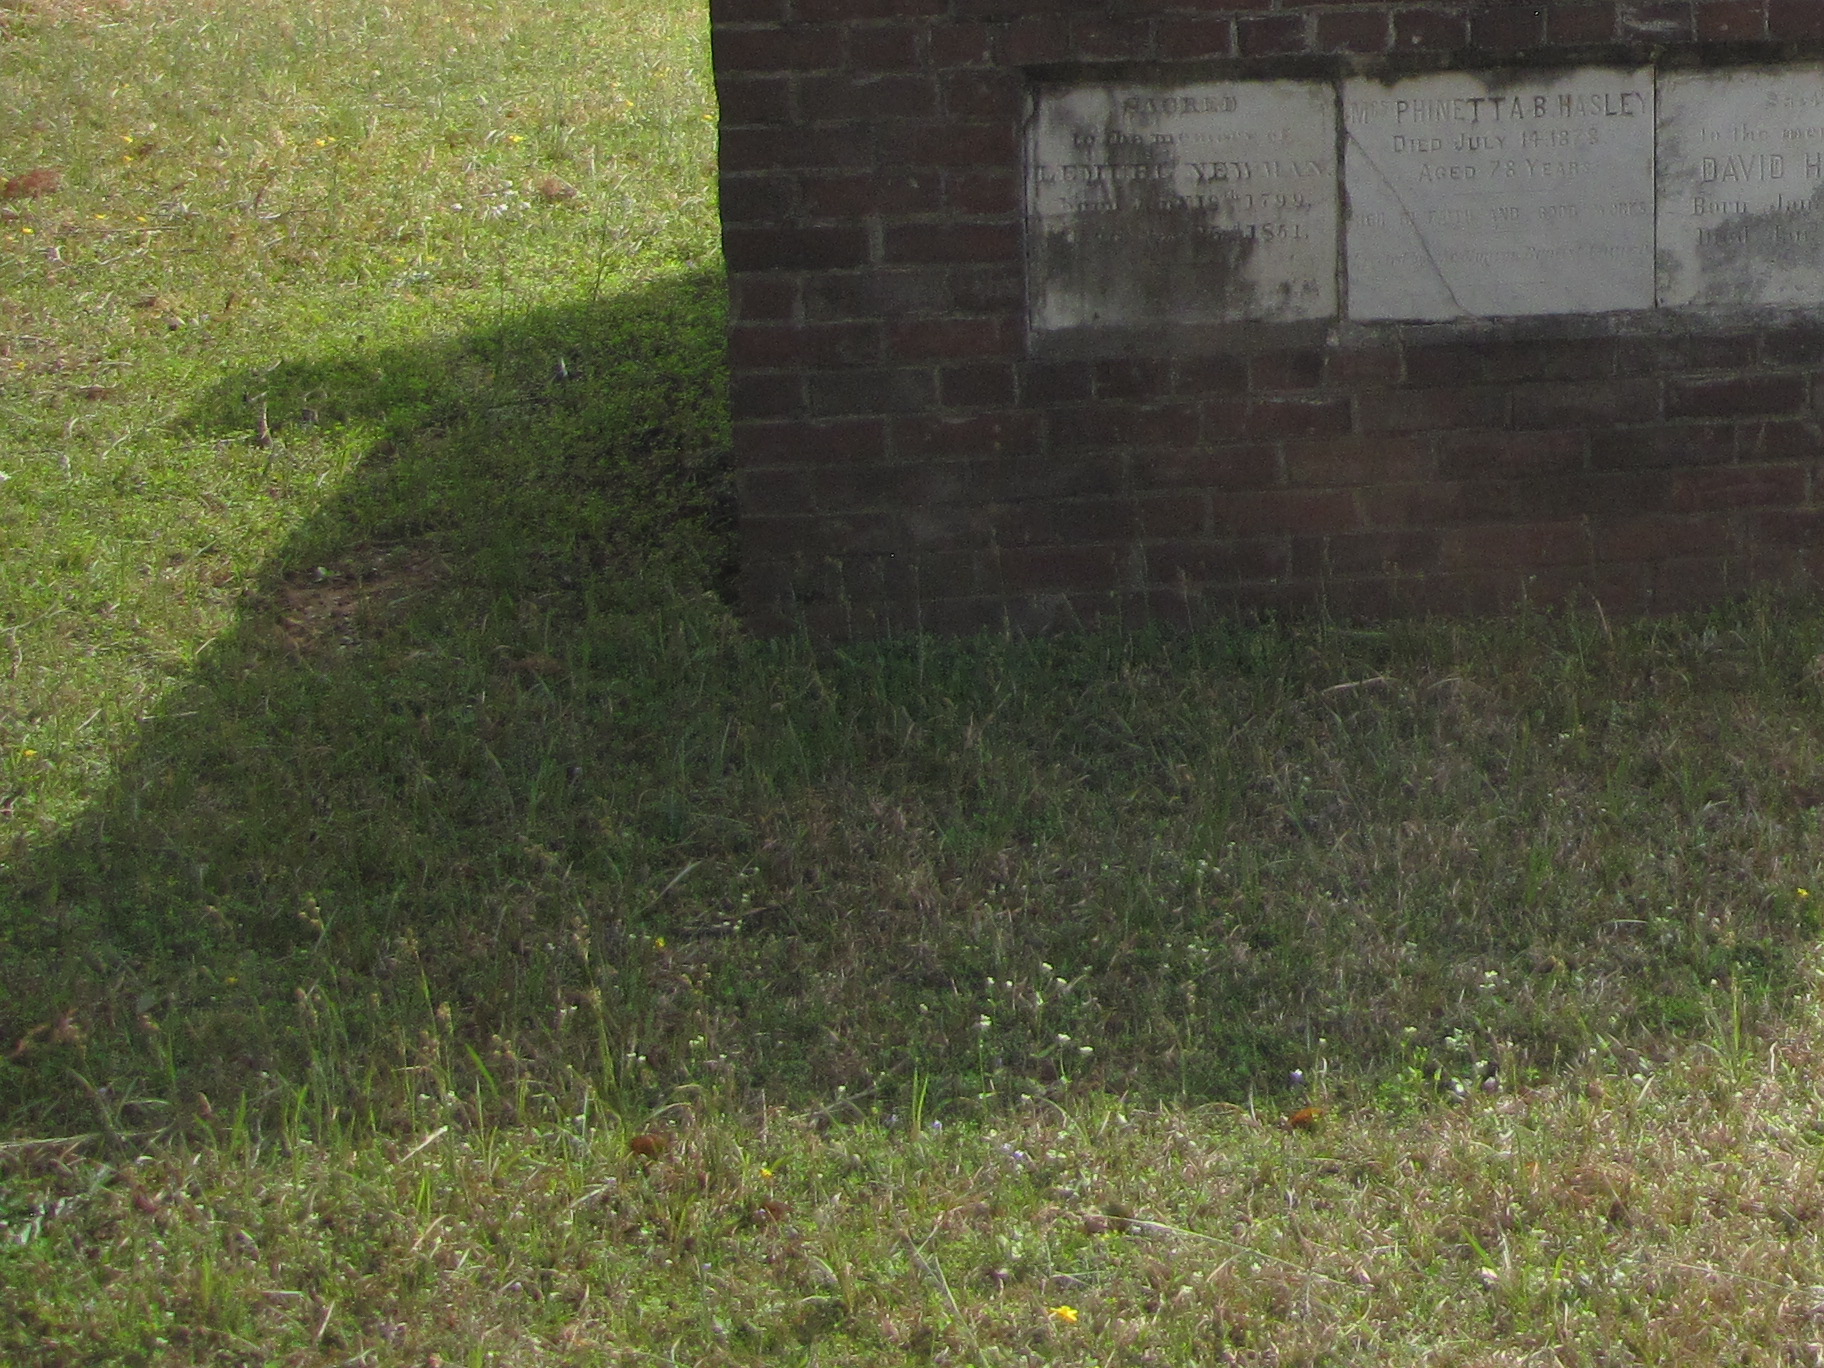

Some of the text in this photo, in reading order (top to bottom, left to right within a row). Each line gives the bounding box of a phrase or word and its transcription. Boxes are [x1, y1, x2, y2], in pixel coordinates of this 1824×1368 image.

[1122, 96, 1239, 114] SACRED
[1396, 96, 1526, 125] PHINETTA
[1558, 92, 1647, 118] HASLEY
[1733, 123, 1770, 142] the
[1419, 163, 1476, 182] AGED
[1490, 160, 1517, 179] 78
[1700, 154, 1785, 184] DAVID
[1490, 207, 1521, 222] AND
[1693, 196, 1750, 218] Born
